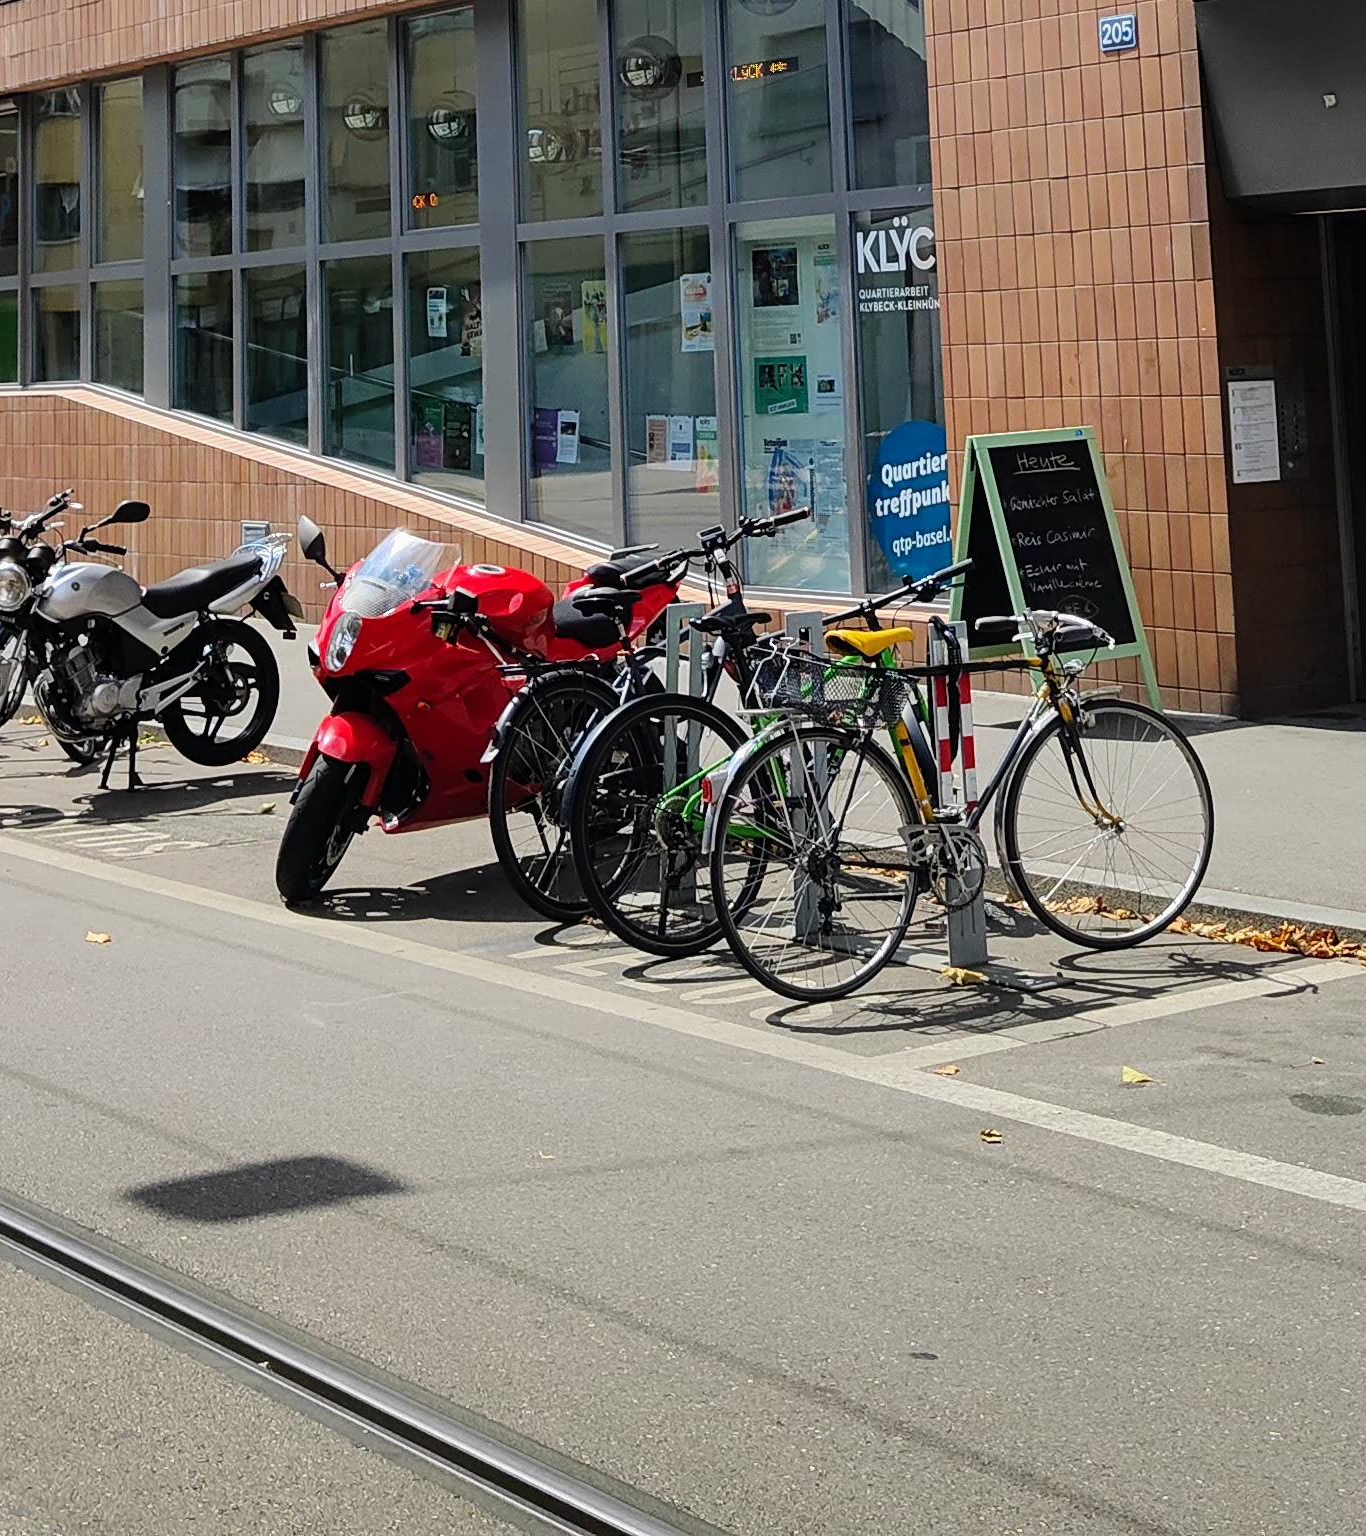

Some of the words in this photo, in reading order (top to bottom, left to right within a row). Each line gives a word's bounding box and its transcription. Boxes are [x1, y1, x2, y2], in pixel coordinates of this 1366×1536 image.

[1102, 20, 1132, 45] 205
[856, 215, 936, 274] KLŸC
[858, 285, 929, 300] QUARTIERARBEIT
[1016, 451, 1075, 473] Heute
[1062, 488, 1095, 504] Salat
[1016, 531, 1042, 547] Reis
